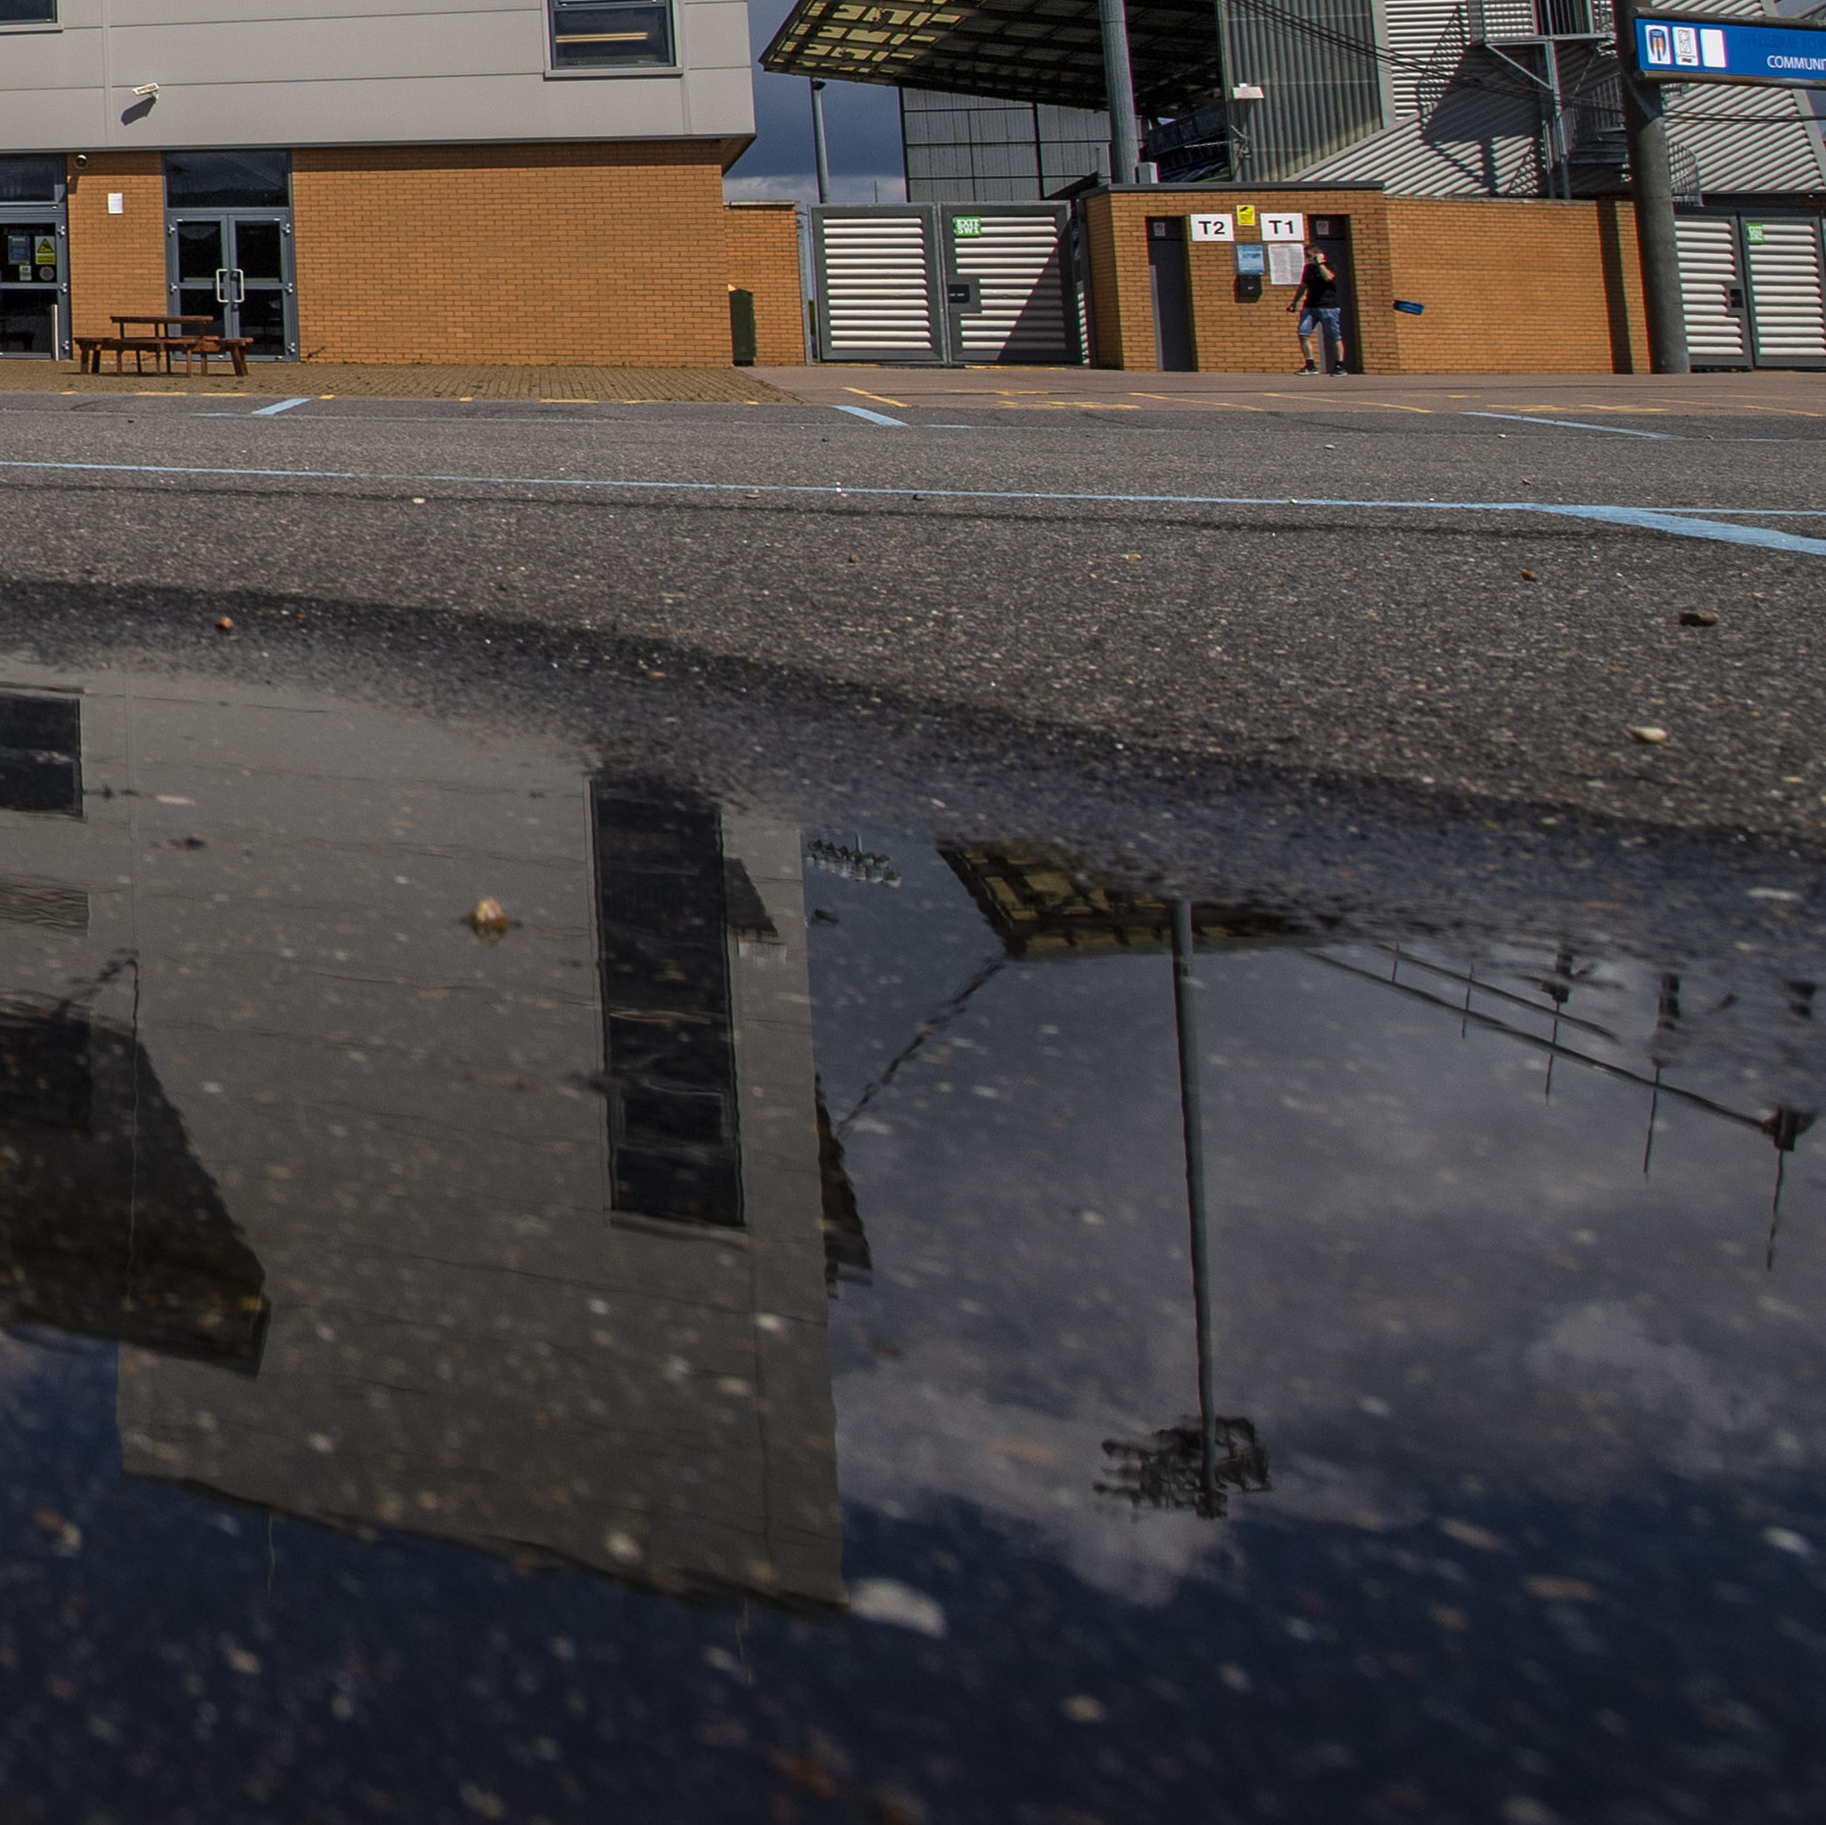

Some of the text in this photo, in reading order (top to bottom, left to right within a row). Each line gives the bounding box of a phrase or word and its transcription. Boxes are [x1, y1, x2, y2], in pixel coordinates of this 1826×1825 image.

[1767, 55, 1826, 71] COMMUNI
[1198, 221, 1226, 235] T2
[1268, 220, 1294, 235] T1
